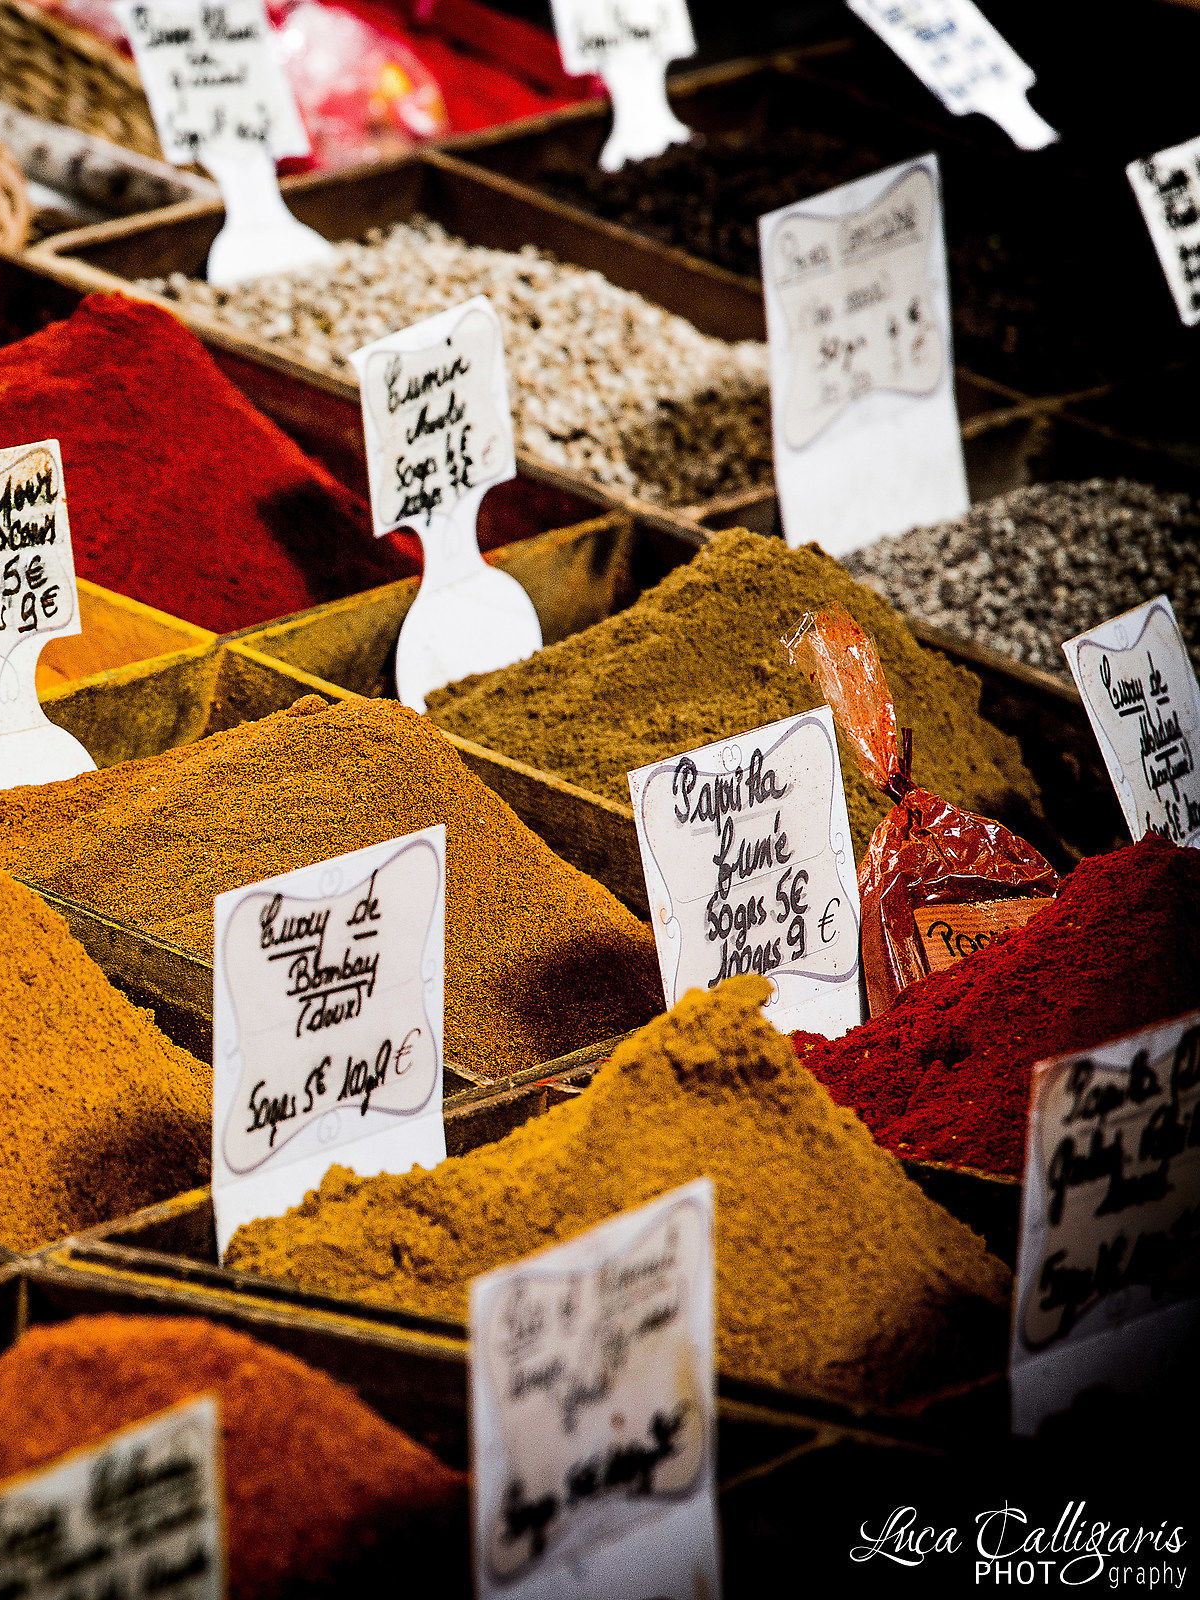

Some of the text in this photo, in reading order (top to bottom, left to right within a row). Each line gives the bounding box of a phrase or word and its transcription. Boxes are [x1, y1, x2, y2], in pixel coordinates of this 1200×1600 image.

[673, 748, 788, 836] Paprika
[346, 869, 381, 926] de
[713, 810, 793, 900] fumé
